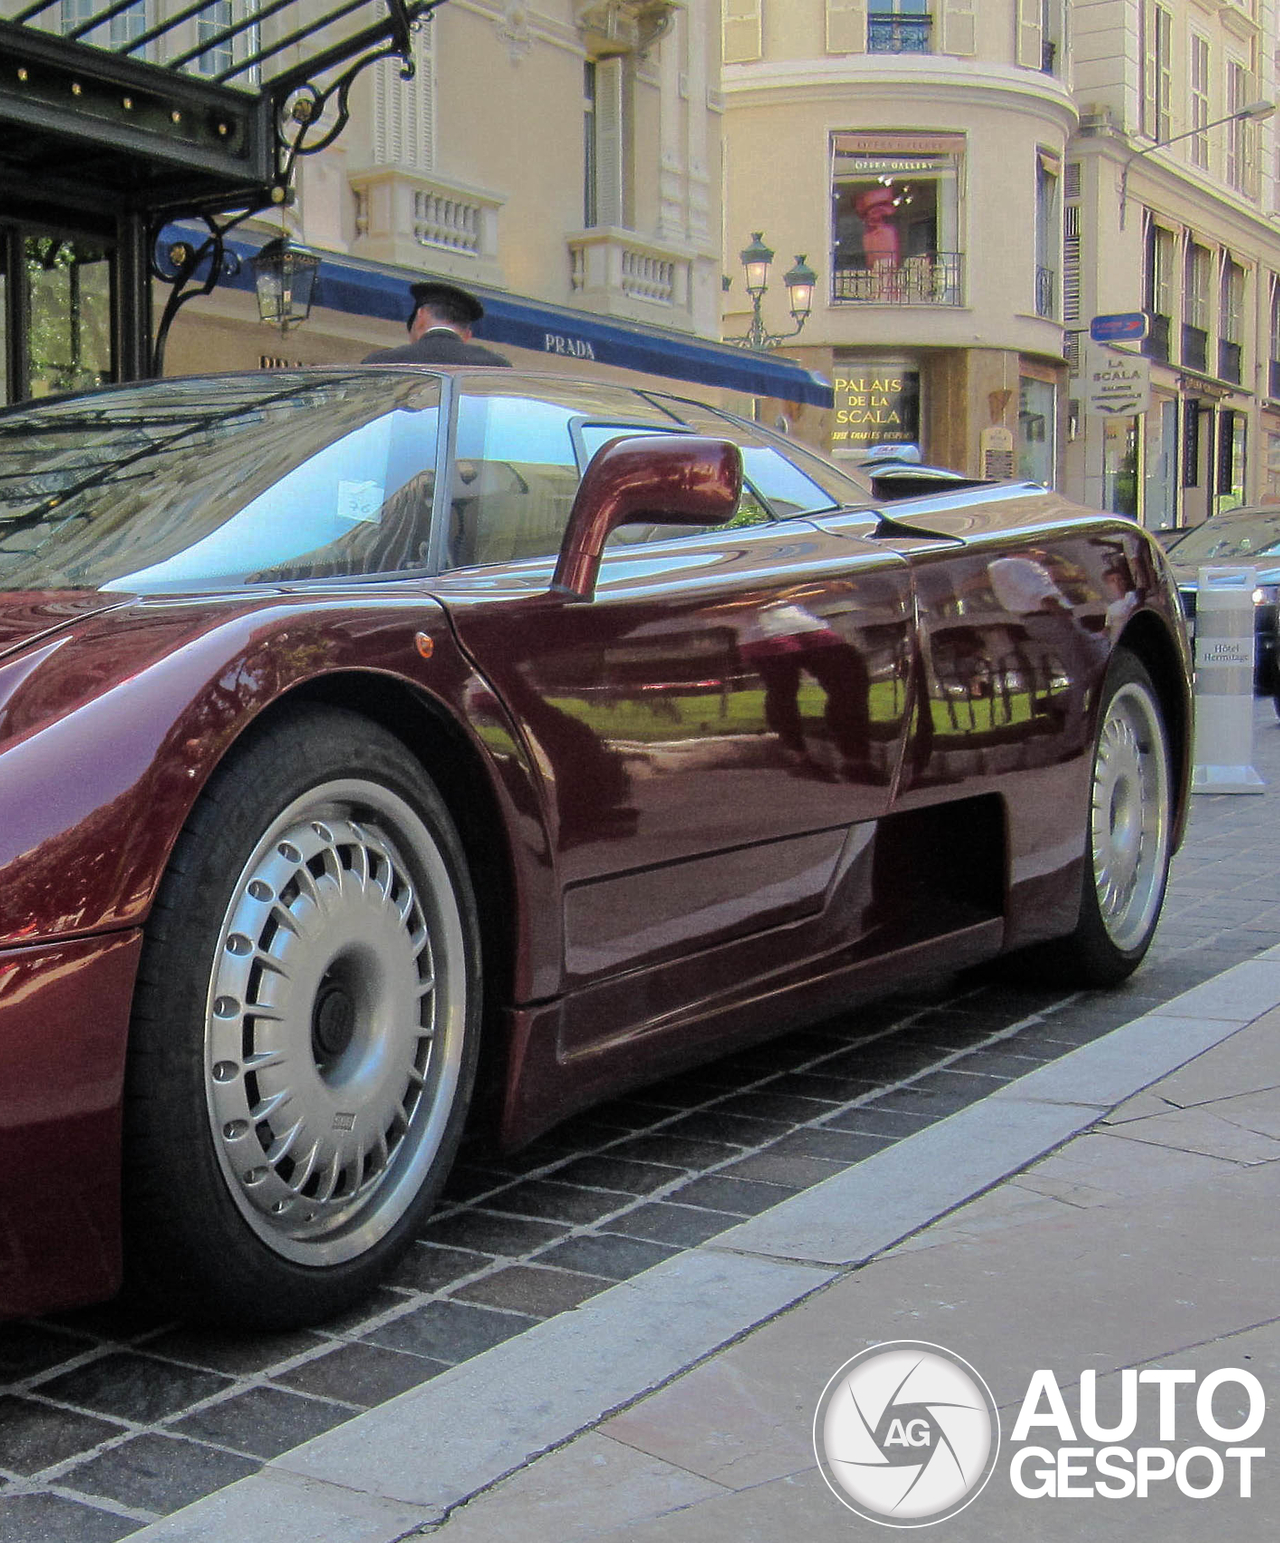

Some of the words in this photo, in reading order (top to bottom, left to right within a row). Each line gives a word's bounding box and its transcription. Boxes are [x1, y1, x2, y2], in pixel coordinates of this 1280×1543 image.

[891, 161, 933, 169] GALLERY
[545, 334, 595, 360] PRADA
[1108, 360, 1124, 368] LA
[1093, 370, 1141, 382] SCALA
[834, 378, 903, 392] PALAIS
[848, 396, 866, 406] DE
[871, 396, 889, 406] LA
[836, 409, 901, 424] SCALA
[1214, 643, 1239, 652] Hôtel
[1203, 653, 1249, 663] Hermitage
